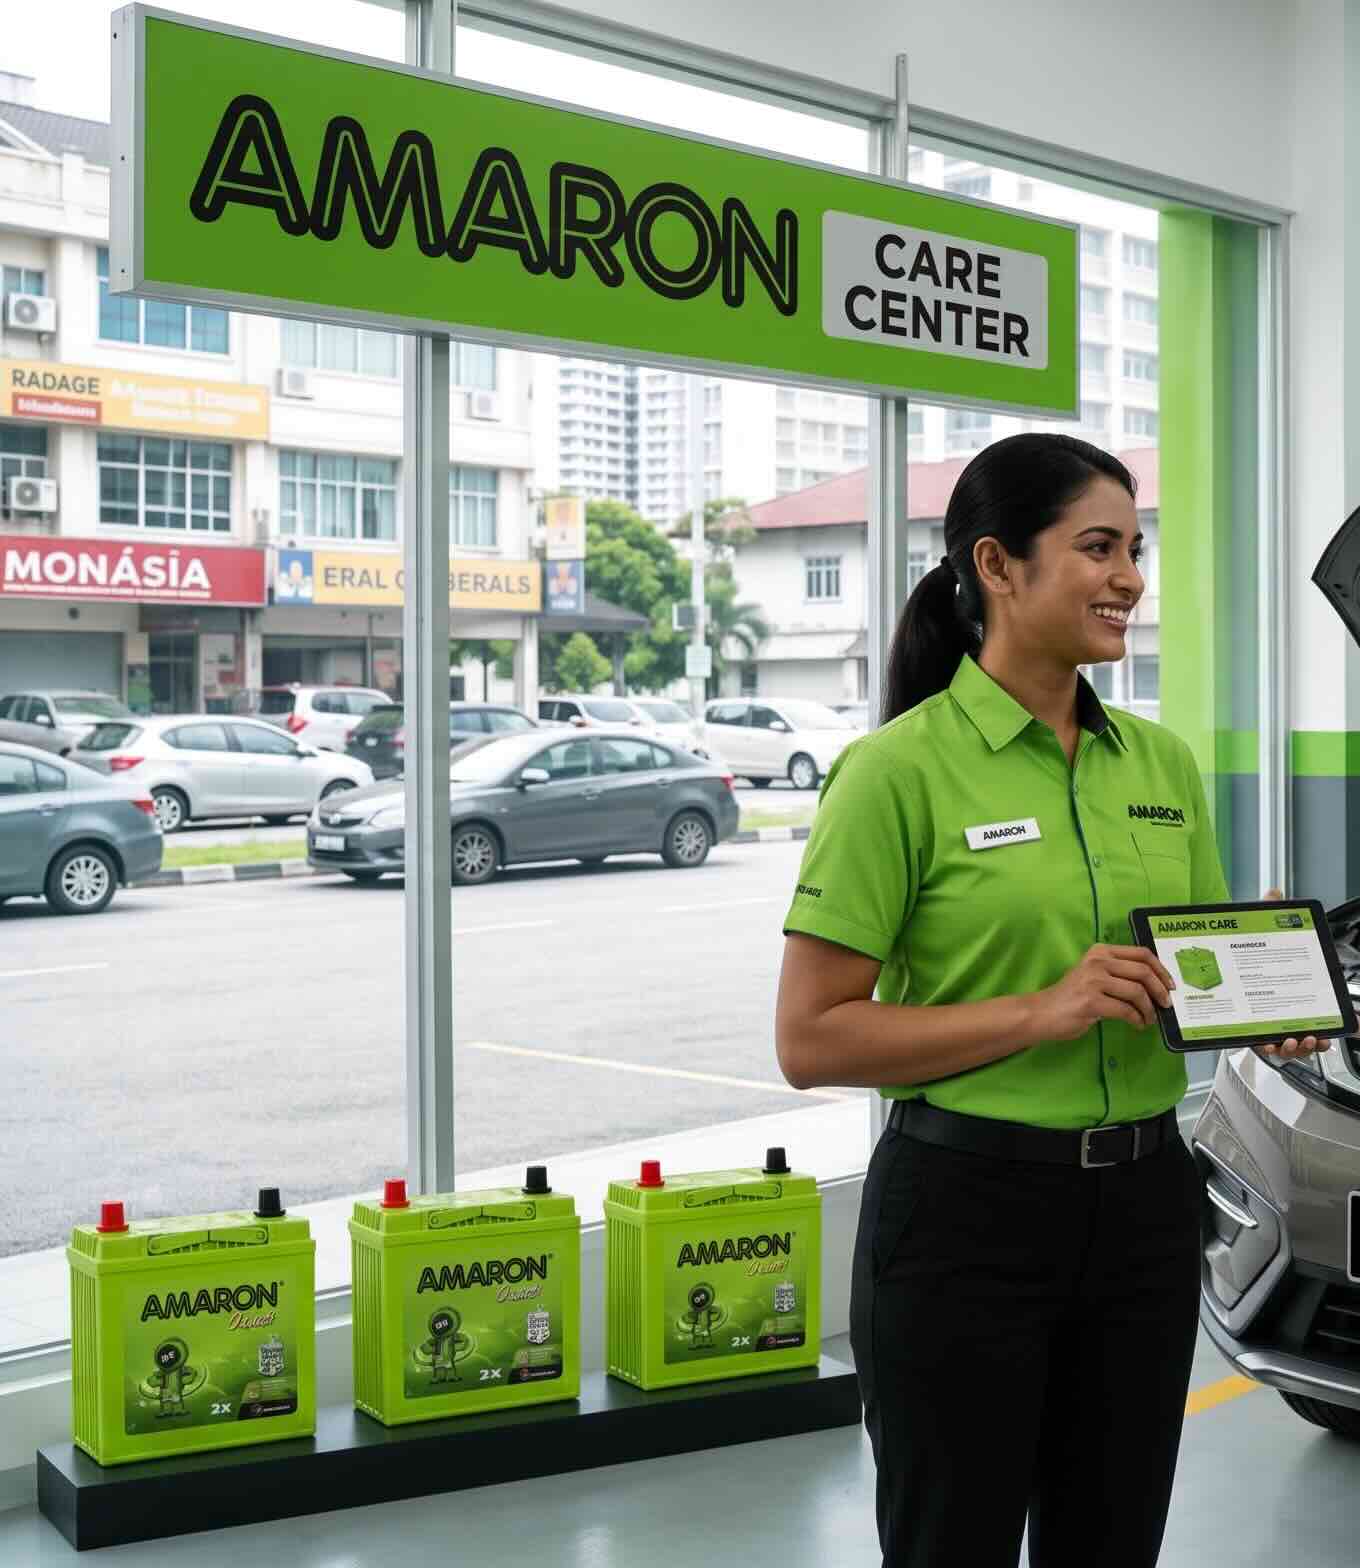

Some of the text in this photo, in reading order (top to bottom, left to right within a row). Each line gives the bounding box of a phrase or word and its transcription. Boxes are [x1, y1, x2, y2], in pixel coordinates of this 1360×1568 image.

[189, 94, 798, 317] AMARON
[875, 233, 1001, 298] CARE
[844, 285, 1031, 357] CENTER
[12, 368, 101, 395] RADAGE
[323, 567, 388, 589] ERAL
[1128, 804, 1185, 823] AMARON
[1158, 919, 1238, 932] AMARON CARE
[677, 1232, 791, 1268] AMARON
[417, 1254, 548, 1294] AMARON
[141, 1281, 278, 1322] AMARON
